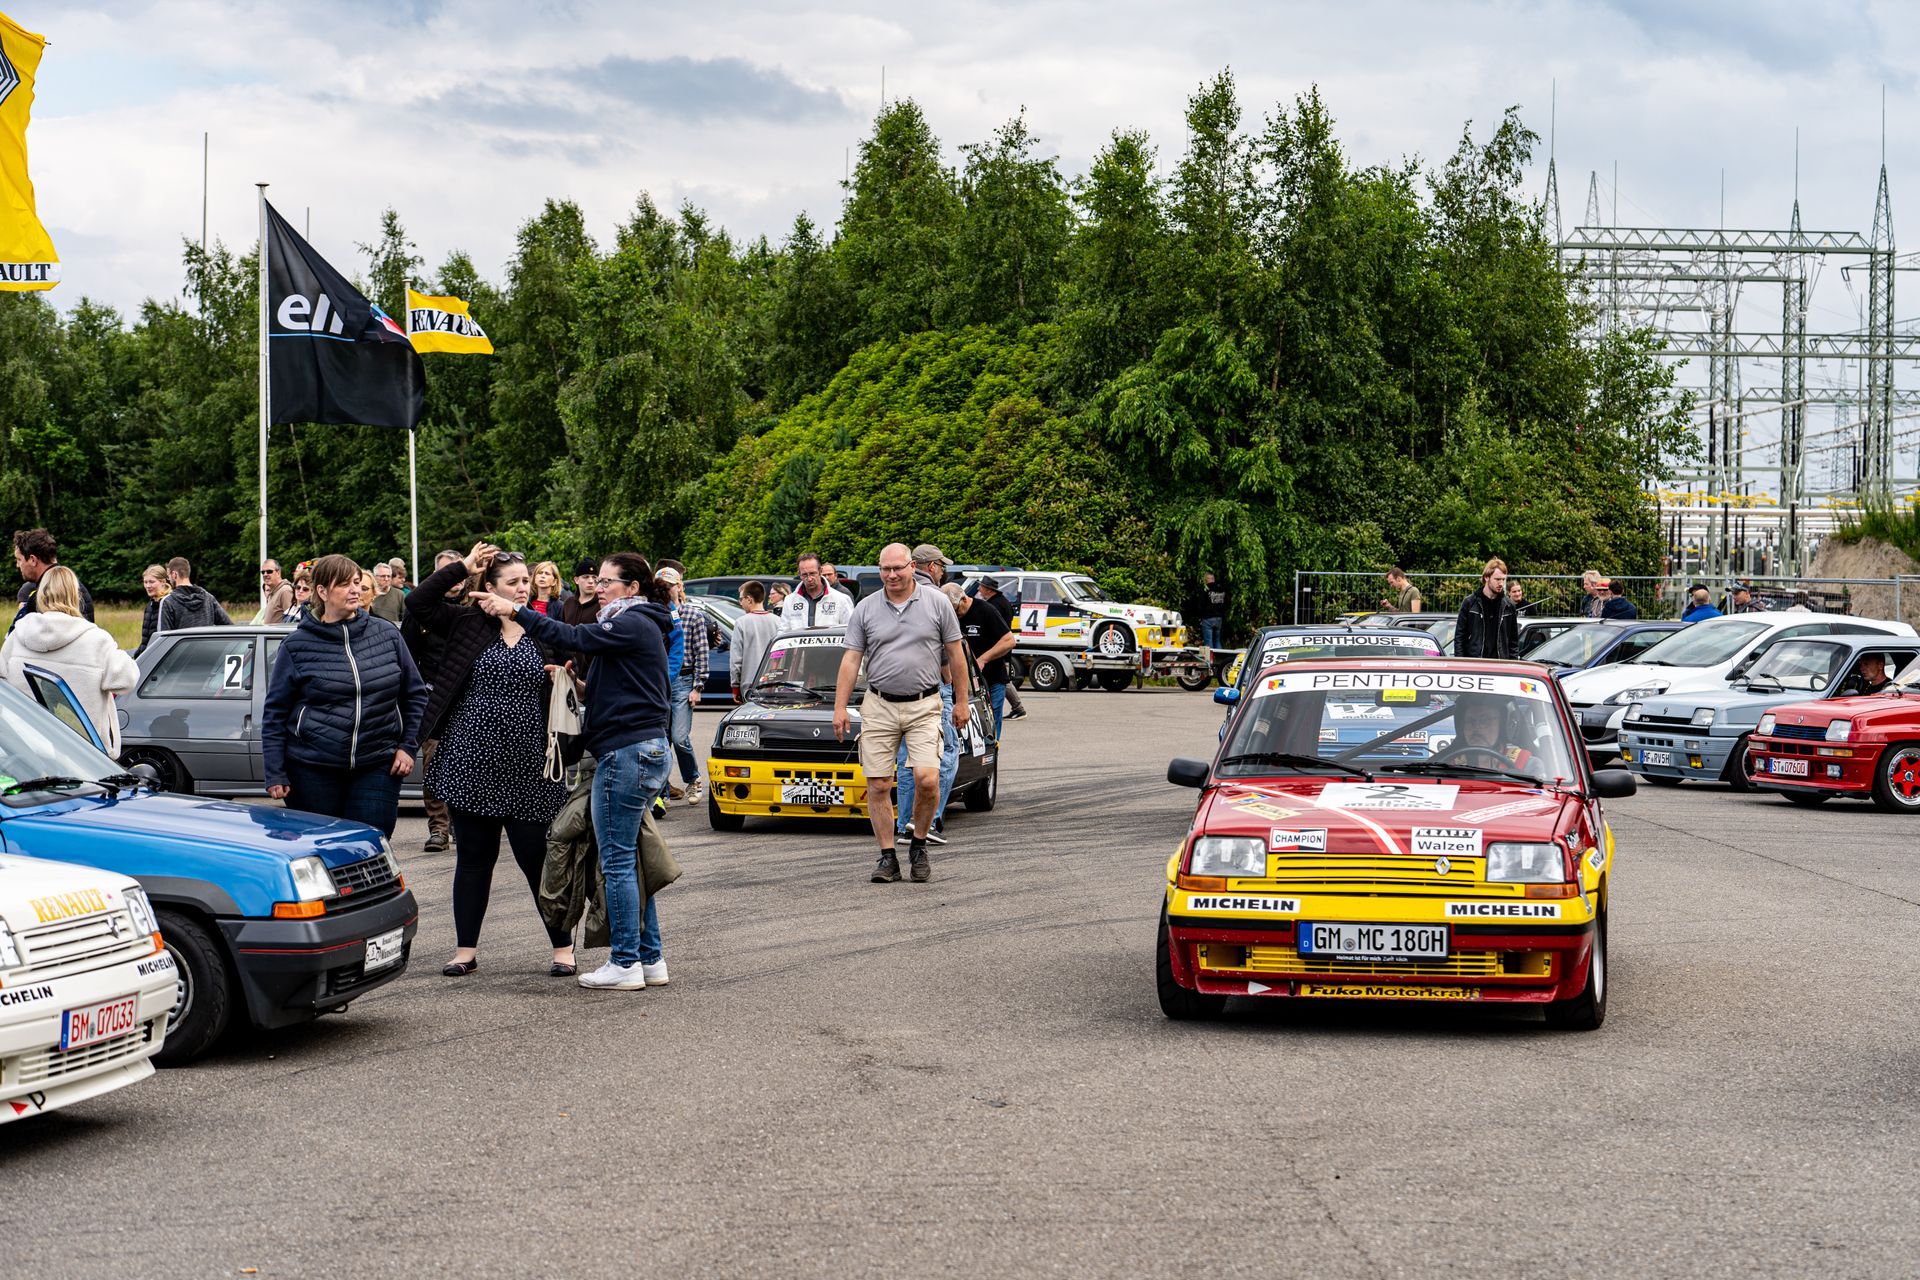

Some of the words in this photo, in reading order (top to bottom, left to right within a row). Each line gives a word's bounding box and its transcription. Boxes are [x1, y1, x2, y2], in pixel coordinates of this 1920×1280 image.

[1025, 609, 1039, 631] 4
[1302, 636, 1400, 646] PENTHOUSE
[1263, 654, 1288, 665] 35
[225, 655, 242, 687] 2
[1312, 674, 1495, 691] PENTHOUSE
[726, 730, 755, 738] BILSTEIN
[1275, 834, 1322, 844] CHAMPION
[1418, 840, 1475, 851] Walzen
[29, 888, 107, 923] RENAULT
[1194, 898, 1294, 911] MICHELIN
[1451, 904, 1555, 917] MICHELIN
[1314, 927, 1341, 949] GM
[1358, 928, 1384, 950] MC
[1391, 929, 1444, 952] 180H
[137, 957, 175, 976] MICHELIN
[1309, 986, 1363, 996] Fuko
[71, 1013, 90, 1042] BM
[97, 1000, 134, 1036] 07033
